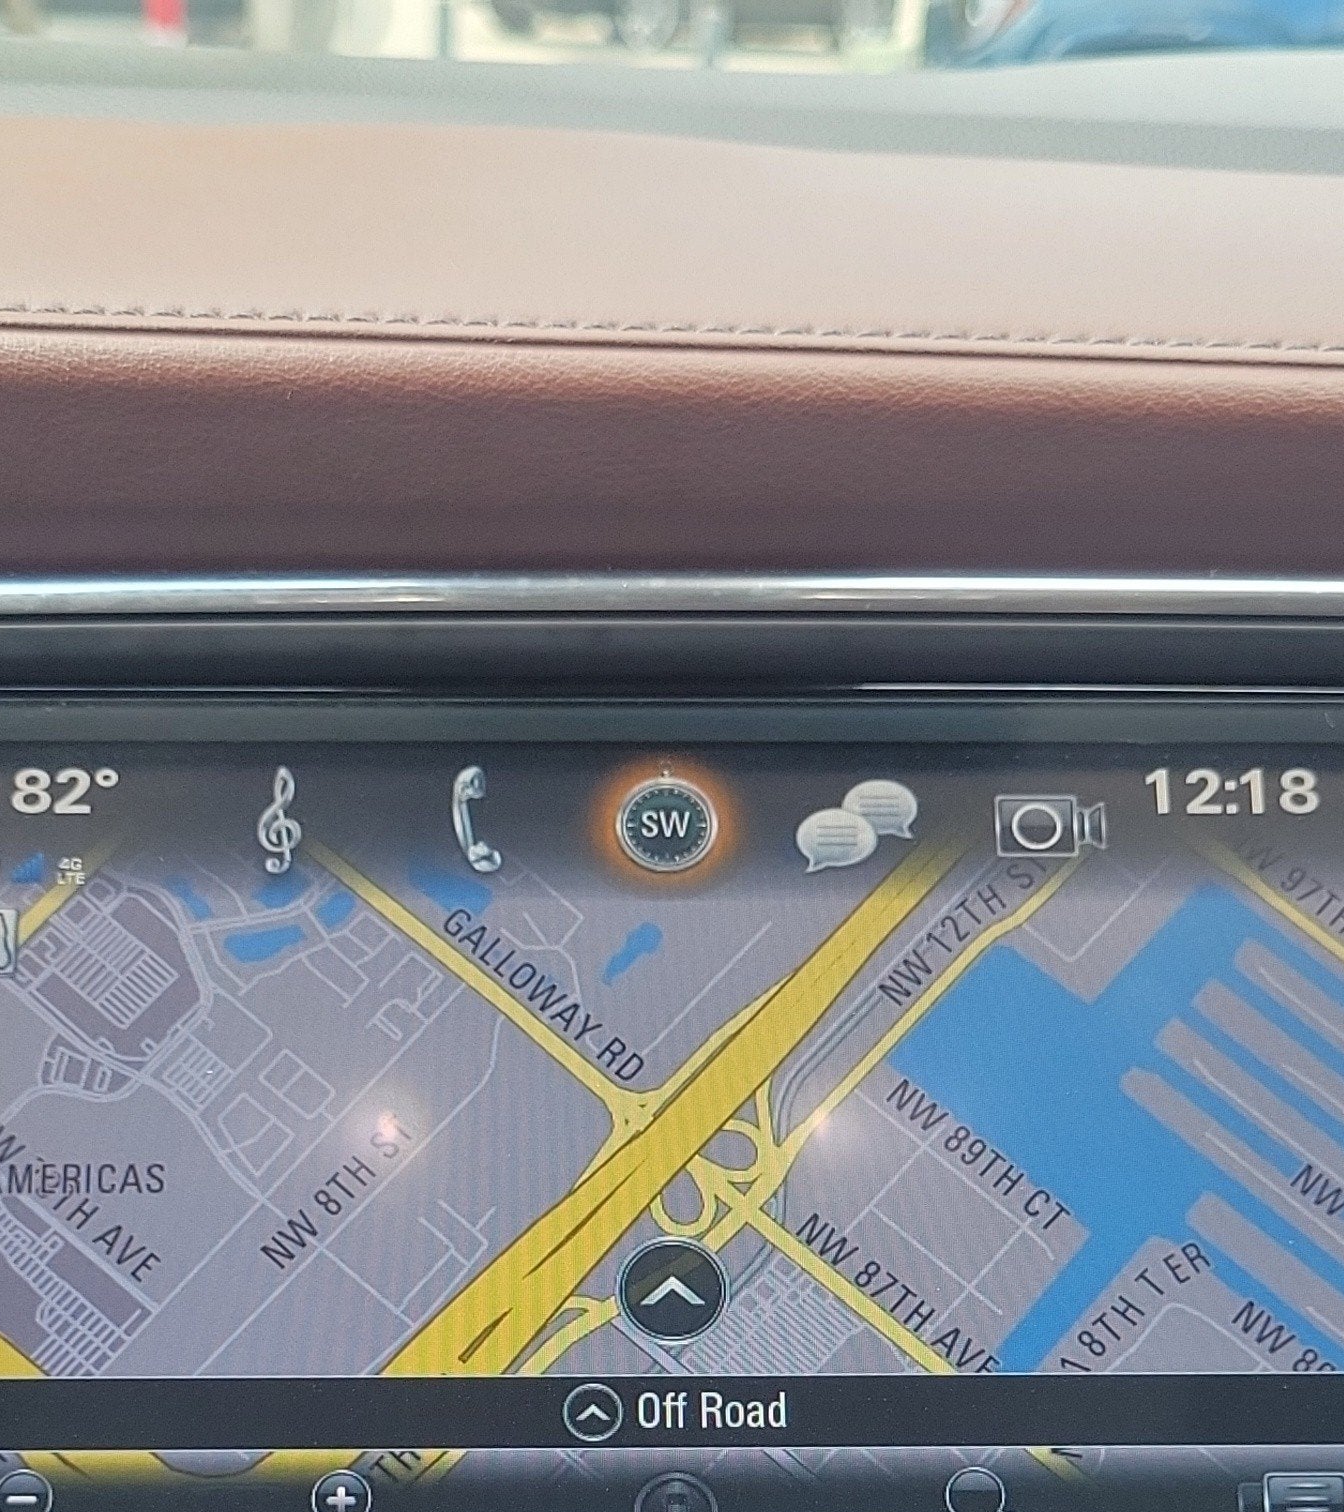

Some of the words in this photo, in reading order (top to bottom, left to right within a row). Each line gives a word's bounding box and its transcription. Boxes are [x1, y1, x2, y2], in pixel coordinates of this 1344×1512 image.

[1144, 767, 1320, 816] 12:18
[641, 810, 690, 838] SW
[57, 872, 87, 886] LTE
[58, 857, 83, 871] 4G
[878, 949, 933, 1007] NW
[926, 883, 1007, 954] 12TH
[443, 908, 604, 1042] GALLOWAY
[596, 1036, 645, 1082] RD
[886, 1078, 950, 1132] NW
[943, 1125, 1025, 1197] 89TH
[1023, 1189, 1072, 1231] CT
[259, 1208, 319, 1270] NW
[313, 1154, 377, 1216] 8TH
[91, 1224, 162, 1283] AVE
[795, 1213, 860, 1268] NW
[854, 1260, 937, 1333] 87TH
[1230, 1300, 1296, 1355] NW
[637, 1390, 688, 1429] Off
[700, 1390, 788, 1429] Road
